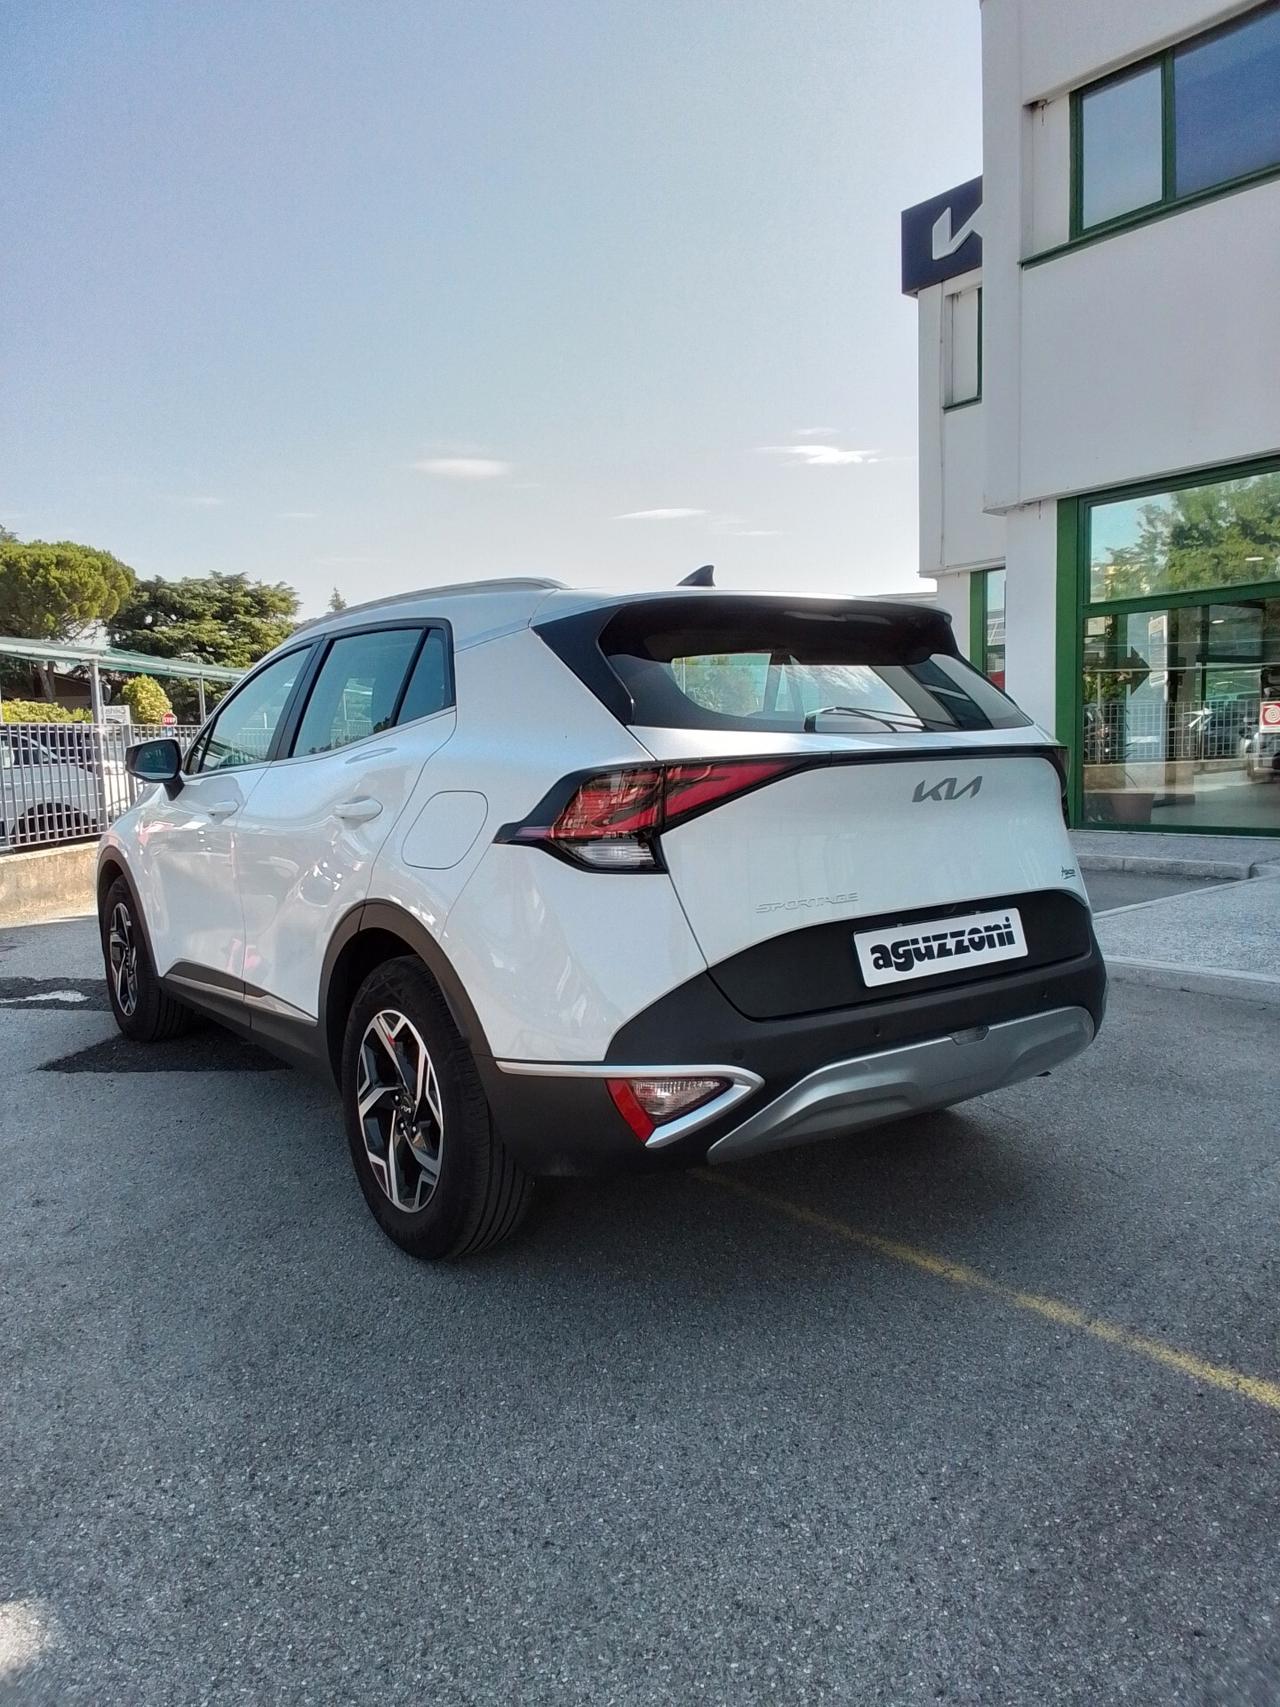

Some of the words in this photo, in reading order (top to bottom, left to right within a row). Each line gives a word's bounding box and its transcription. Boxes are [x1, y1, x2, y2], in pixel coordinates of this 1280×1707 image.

[912, 775, 983, 803] KIA
[756, 892, 860, 914] SPORTAGE
[870, 916, 1016, 972] aguzzoni
